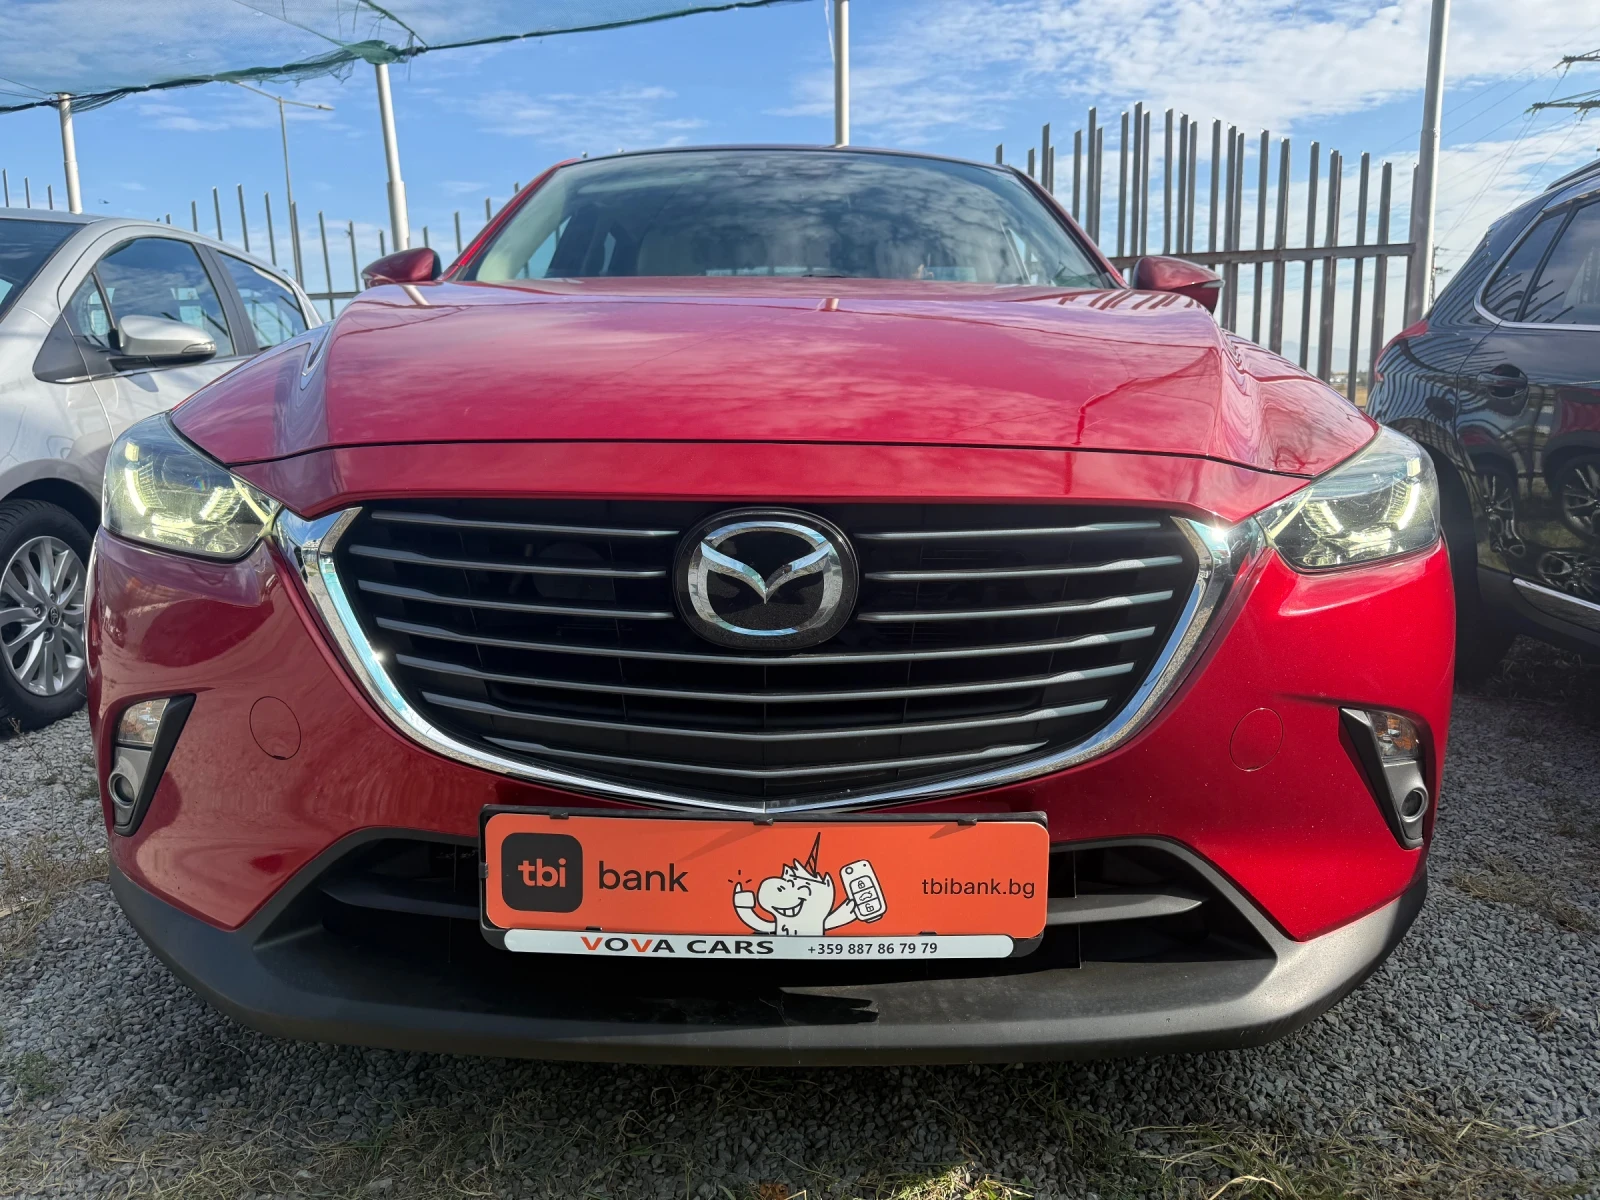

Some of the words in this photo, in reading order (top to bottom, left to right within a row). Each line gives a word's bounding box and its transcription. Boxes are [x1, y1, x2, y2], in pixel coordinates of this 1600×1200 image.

[517, 858, 567, 888] tbi
[598, 860, 689, 893] bank
[922, 878, 1035, 899] tbibank.bg
[581, 936, 676, 954] VOVA
[686, 940, 775, 955] CARS
[807, 944, 844, 955] +359
[847, 943, 872, 955] 887
[877, 943, 895, 955] 86
[899, 943, 917, 955] 79
[921, 942, 938, 954] 79
